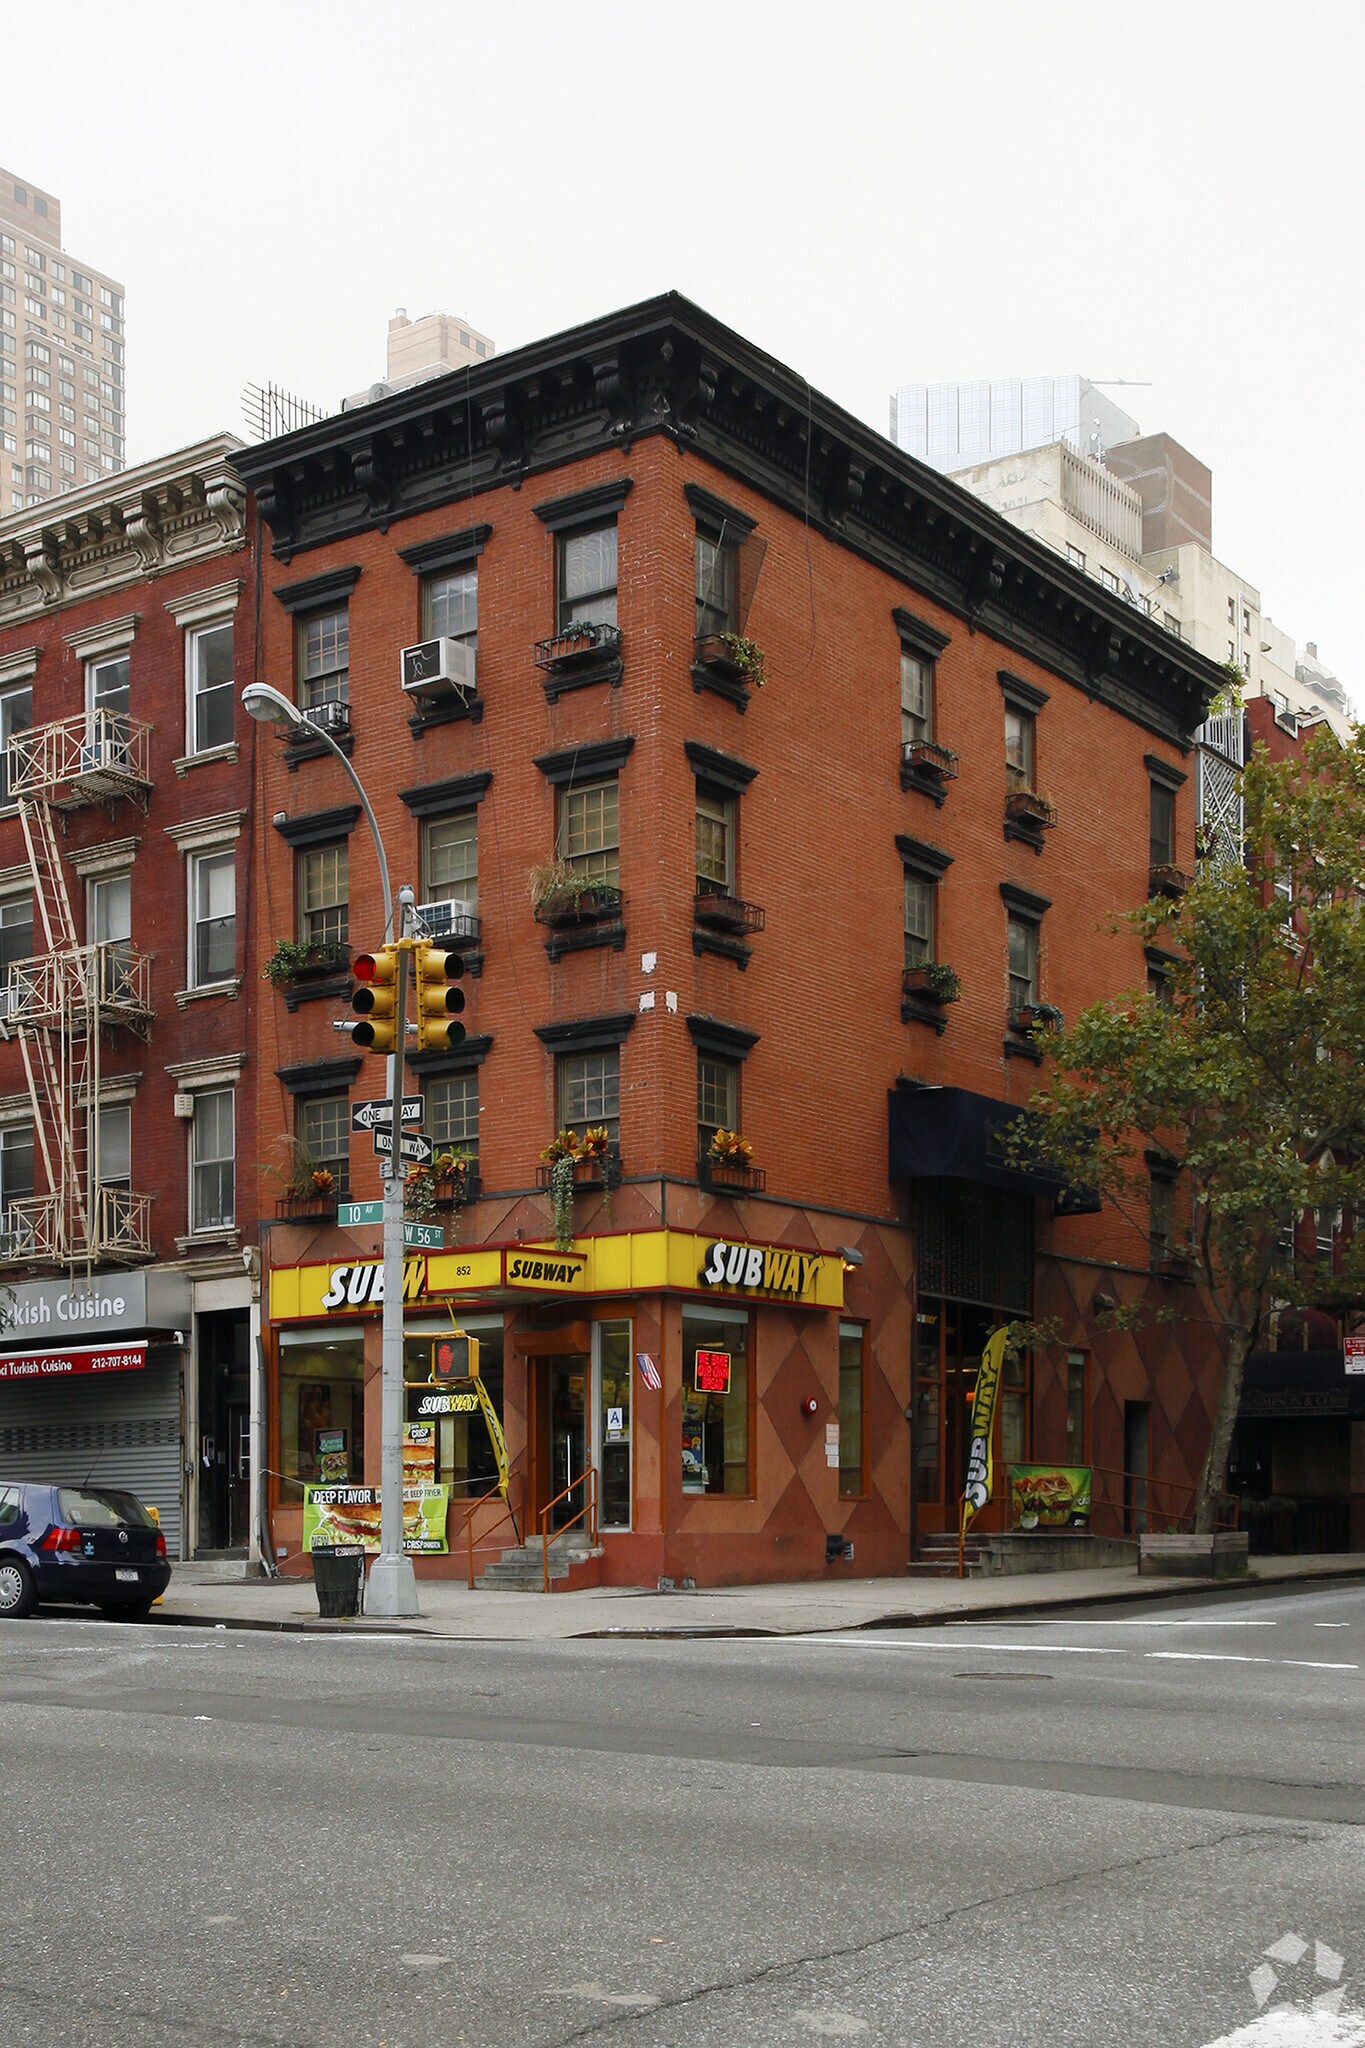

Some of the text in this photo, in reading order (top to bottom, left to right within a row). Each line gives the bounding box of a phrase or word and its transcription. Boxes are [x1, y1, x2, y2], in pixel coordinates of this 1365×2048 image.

[361, 1105, 415, 1122] ONE AY
[382, 1136, 426, 1155] ON WAY
[349, 1205, 374, 1223] 10 AV
[404, 1225, 442, 1245] W 56 ST
[456, 1265, 471, 1276] 852
[508, 1259, 582, 1283] SUBWAY
[702, 1242, 825, 1294] SUBWAY
[56, 1293, 126, 1321] Cuisine
[9, 1360, 39, 1376] Turkish
[41, 1359, 73, 1373] Cuisine
[91, 1354, 142, 1369] 212-707-8144
[418, 1394, 478, 1415] SUBWAY
[610, 1411, 620, 1424] A
[965, 1350, 999, 1511] SUBWAY
[313, 1490, 336, 1504] DEEP
[338, 1489, 372, 1504] FLAVOR
[402, 1487, 442, 1499] HE DEEP FRYER
